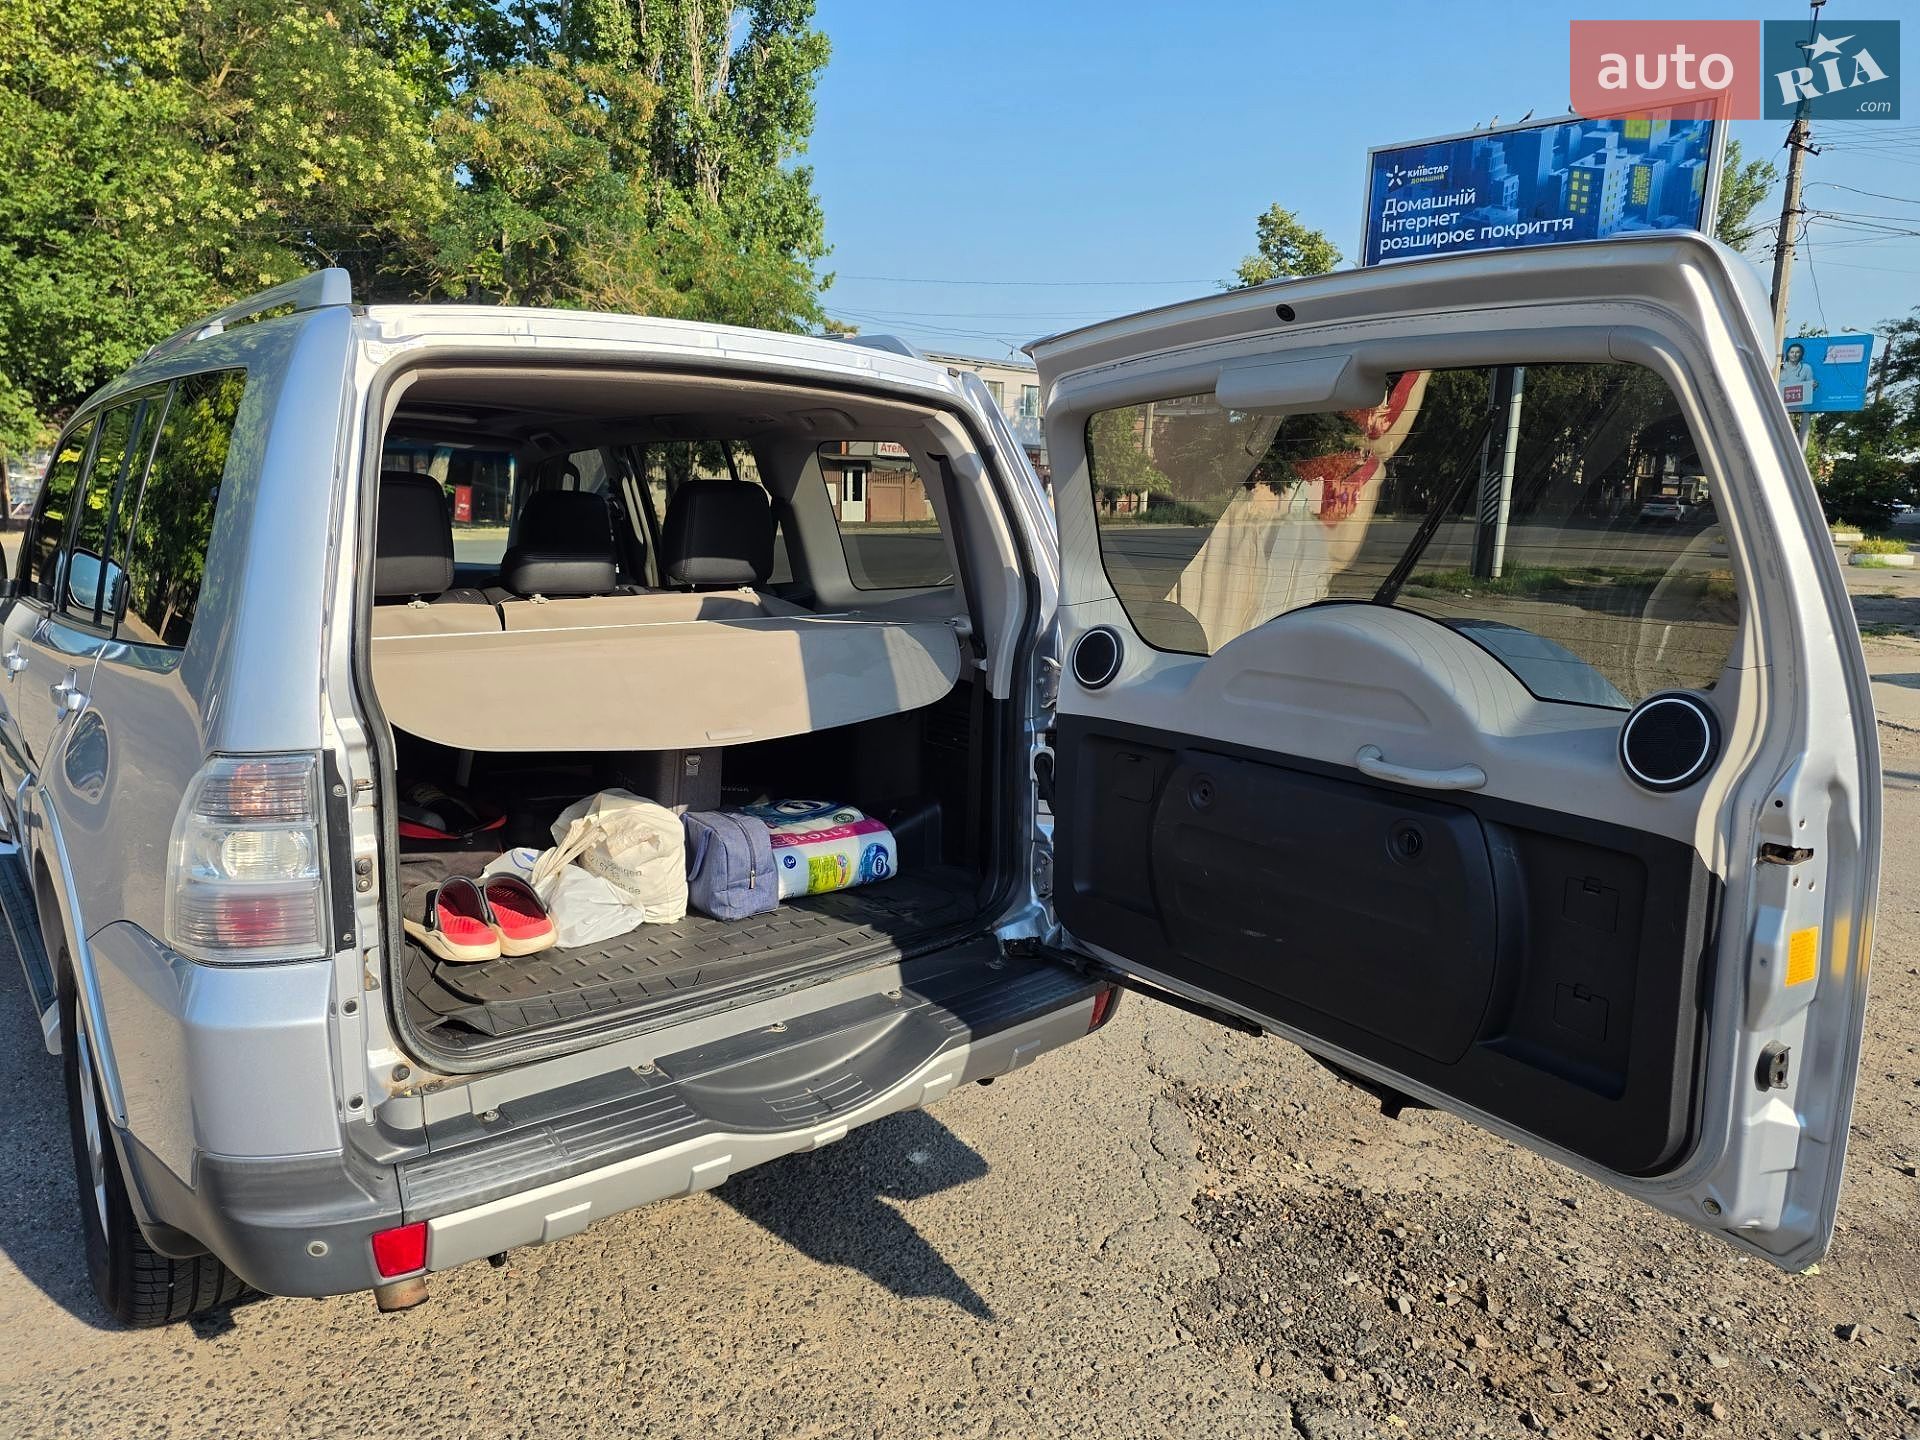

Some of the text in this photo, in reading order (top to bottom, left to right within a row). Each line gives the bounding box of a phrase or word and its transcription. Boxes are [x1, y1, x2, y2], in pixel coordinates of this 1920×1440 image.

[1407, 164, 1449, 178] КИЇВСТАР
[1382, 188, 1476, 217] Домашній
[1381, 212, 1461, 233] Інтернет
[1379, 217, 1574, 255] розширює покриття
